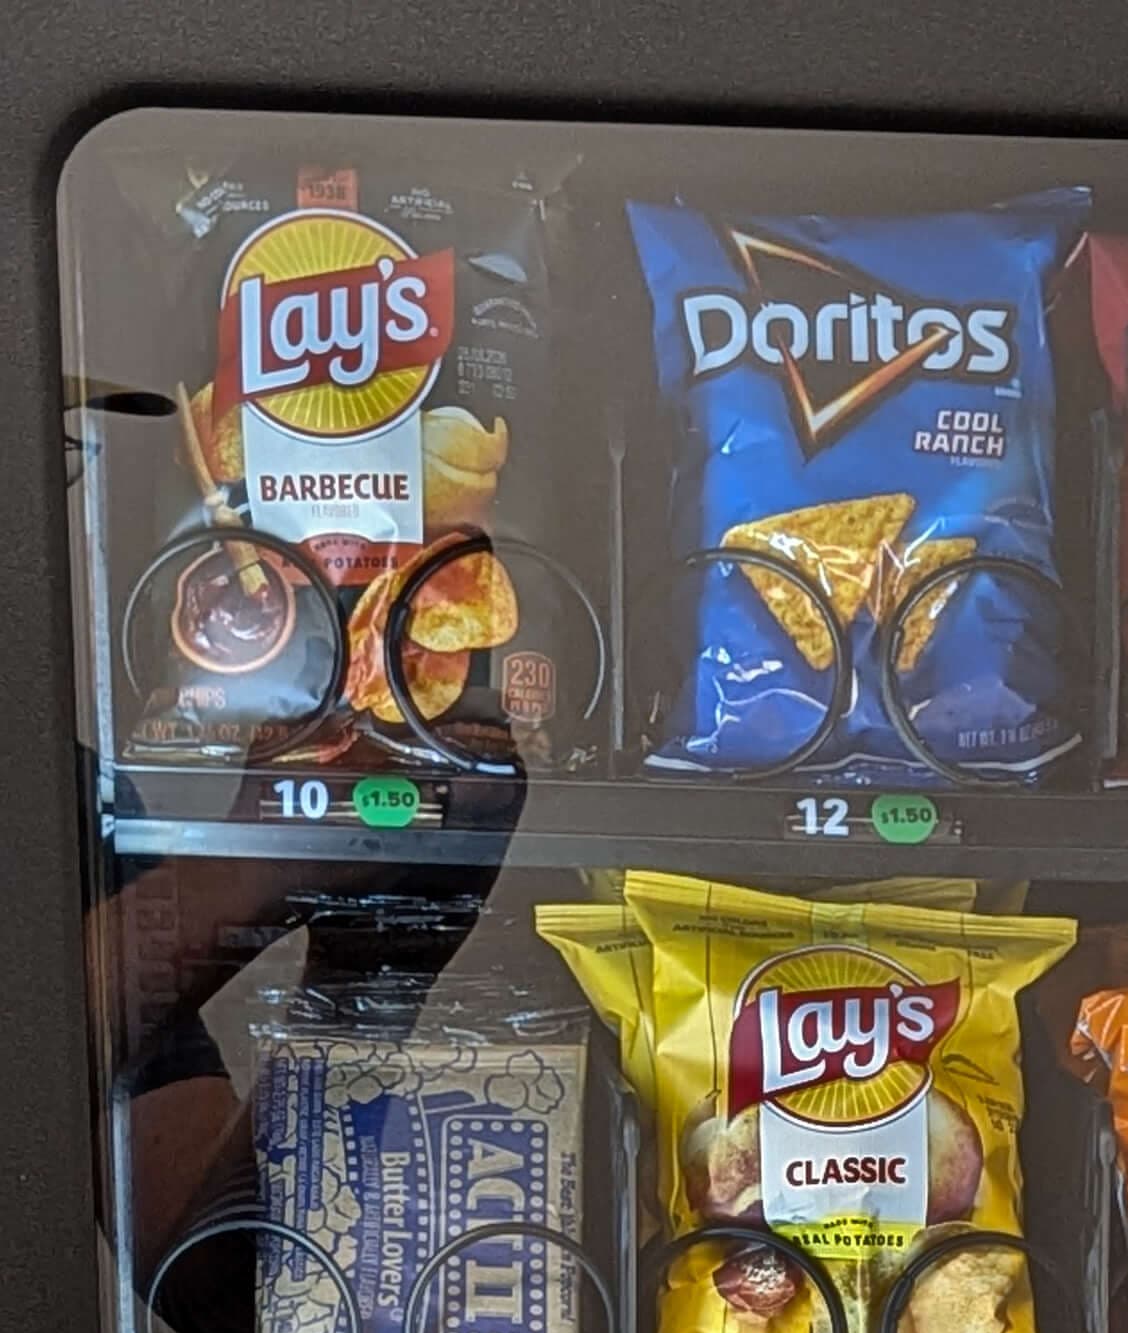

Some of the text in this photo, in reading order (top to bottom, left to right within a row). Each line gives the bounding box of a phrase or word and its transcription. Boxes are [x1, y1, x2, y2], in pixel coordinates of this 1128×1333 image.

[239, 258, 432, 394] Lay's
[684, 291, 1010, 376] Doritos
[937, 411, 1004, 433] COOL
[914, 431, 1005, 457] RANCH
[260, 473, 409, 501] BARBECUE
[510, 659, 550, 687] 230
[274, 779, 328, 819] 10
[361, 790, 416, 808] $1.50
[797, 800, 849, 836] 12
[880, 806, 933, 825] $1.50
[758, 984, 935, 1095] Lay's
[785, 1156, 907, 1187] CLASSIC
[377, 1151, 412, 1307] Butter Lovers
[834, 1232, 904, 1247] POTATOES
[465, 1260, 524, 1324] II
